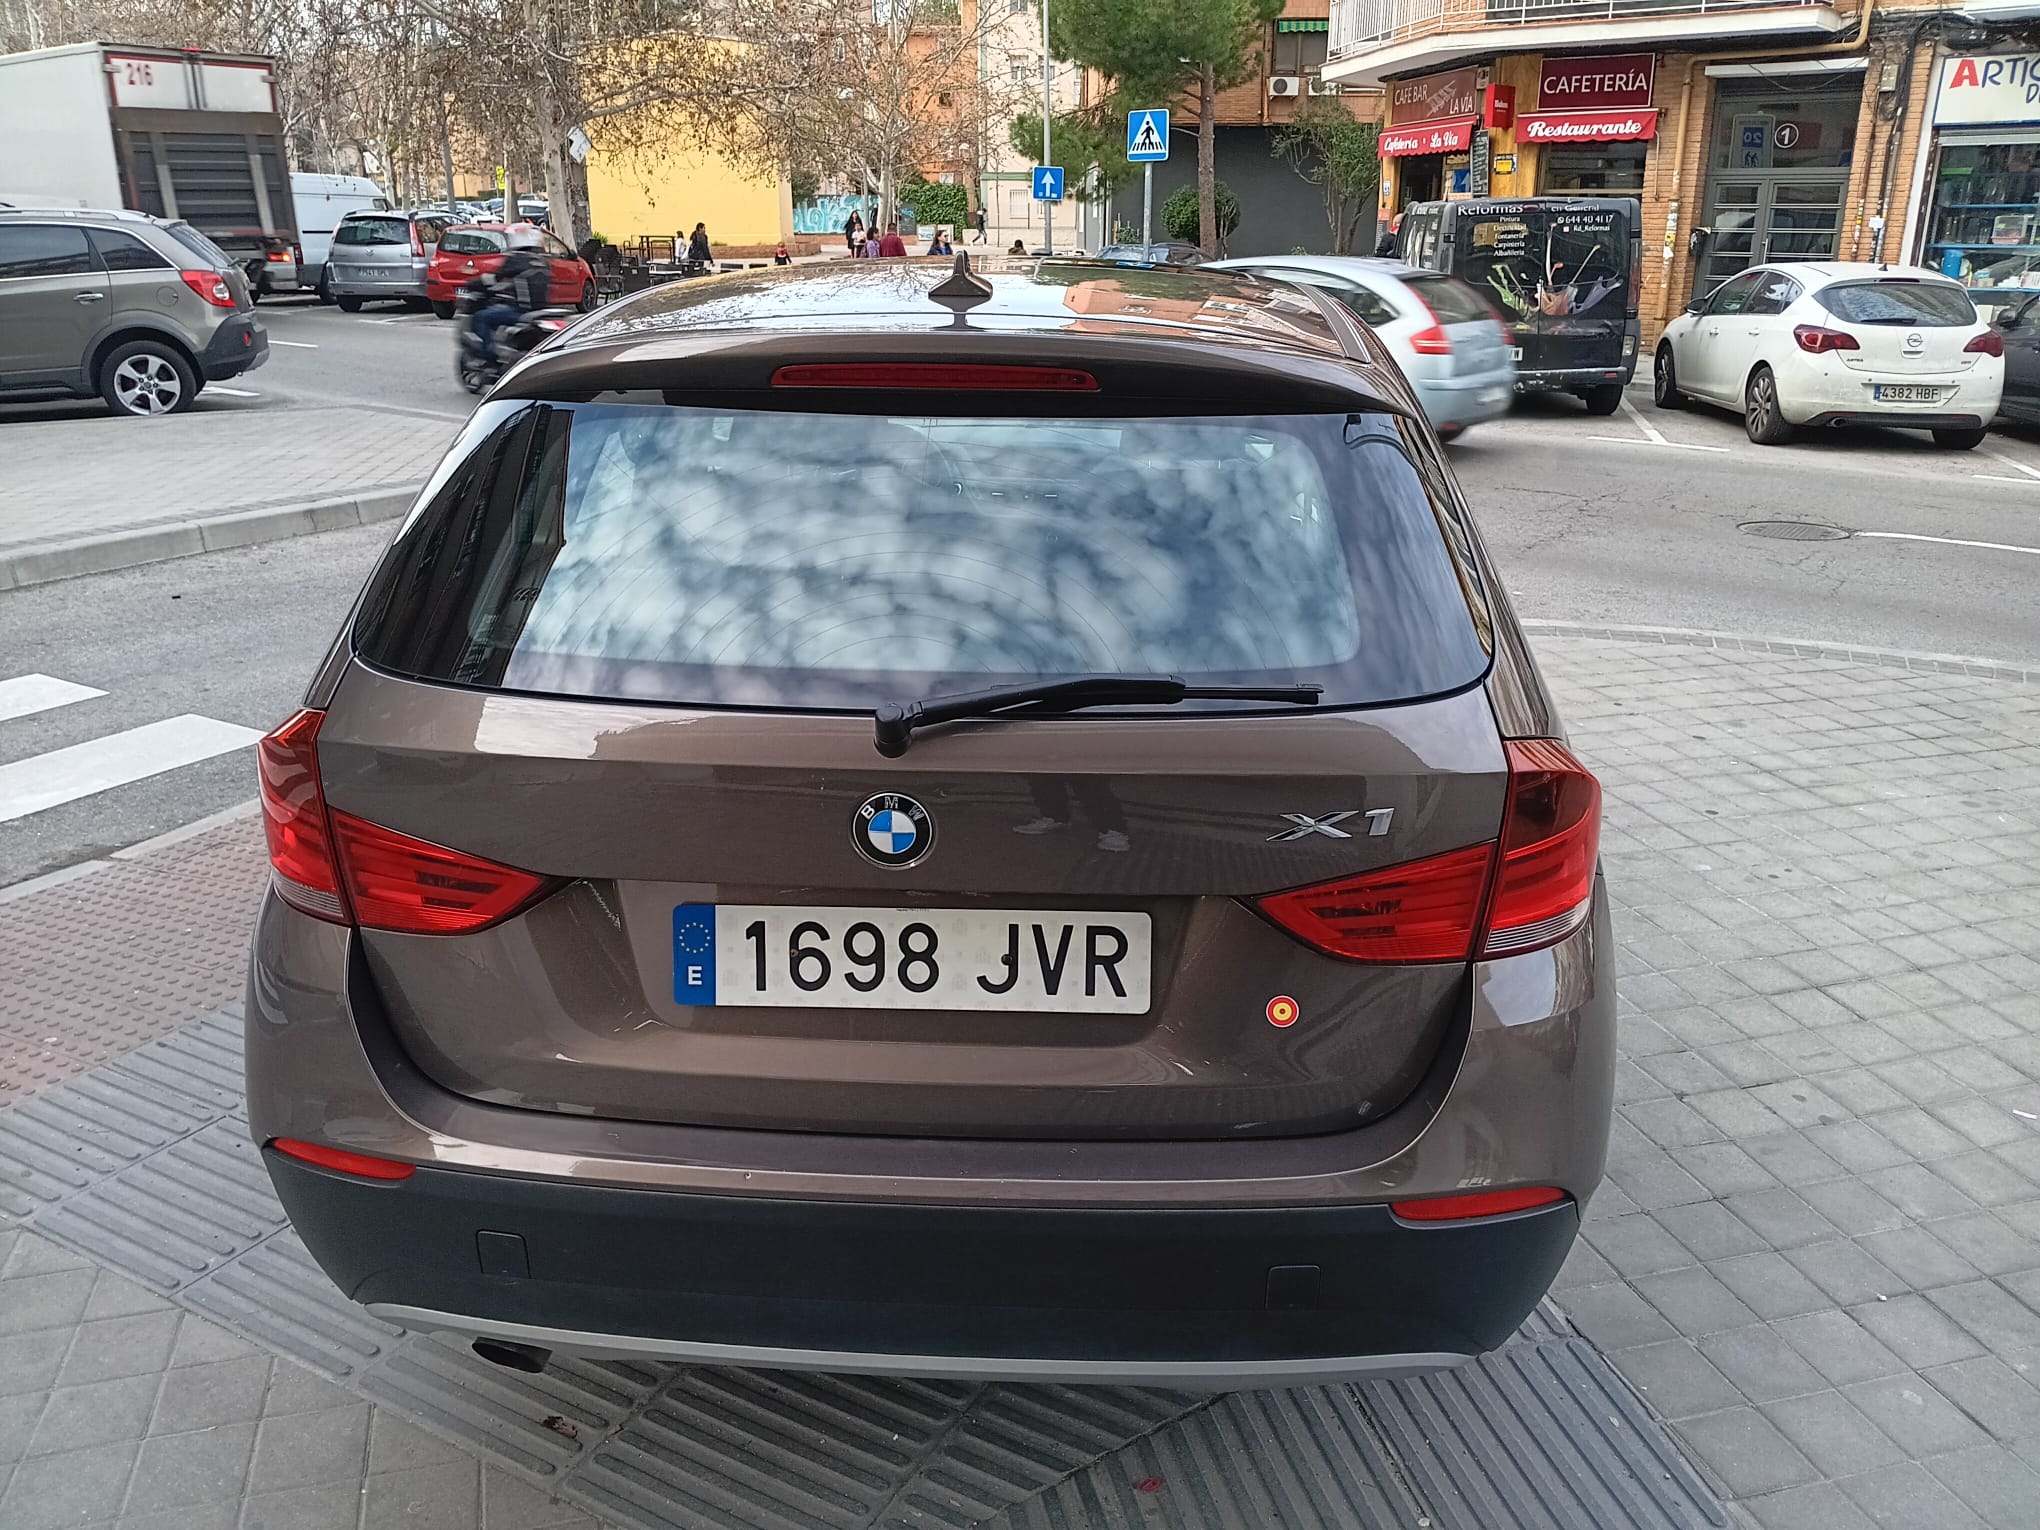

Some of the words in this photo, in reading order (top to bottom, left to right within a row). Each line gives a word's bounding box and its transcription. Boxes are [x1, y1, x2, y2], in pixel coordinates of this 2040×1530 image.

[126, 63, 153, 86] 216
[1543, 68, 1648, 94] CAFETERÍA
[1394, 83, 1412, 106] CAFÉ
[1413, 84, 1428, 102] BAR
[1449, 98, 1459, 114] LA
[1461, 92, 1473, 111] VÍA
[1527, 119, 1642, 137] Restaurante
[1781, 127, 1790, 145] 1
[1430, 132, 1441, 148] La
[1457, 204, 1524, 216] Reformas
[1565, 215, 1580, 224] 644
[1582, 215, 1594, 223] 40
[1595, 215, 1604, 223] 41
[1605, 214, 1614, 223] 17
[1881, 388, 1912, 399] 4382
[1916, 389, 1938, 400] HBF
[861, 796, 924, 821] BMW
[1265, 807, 1395, 842] X1
[687, 966, 702, 985] E
[745, 920, 939, 993] 1698
[976, 923, 1128, 998] JVR
